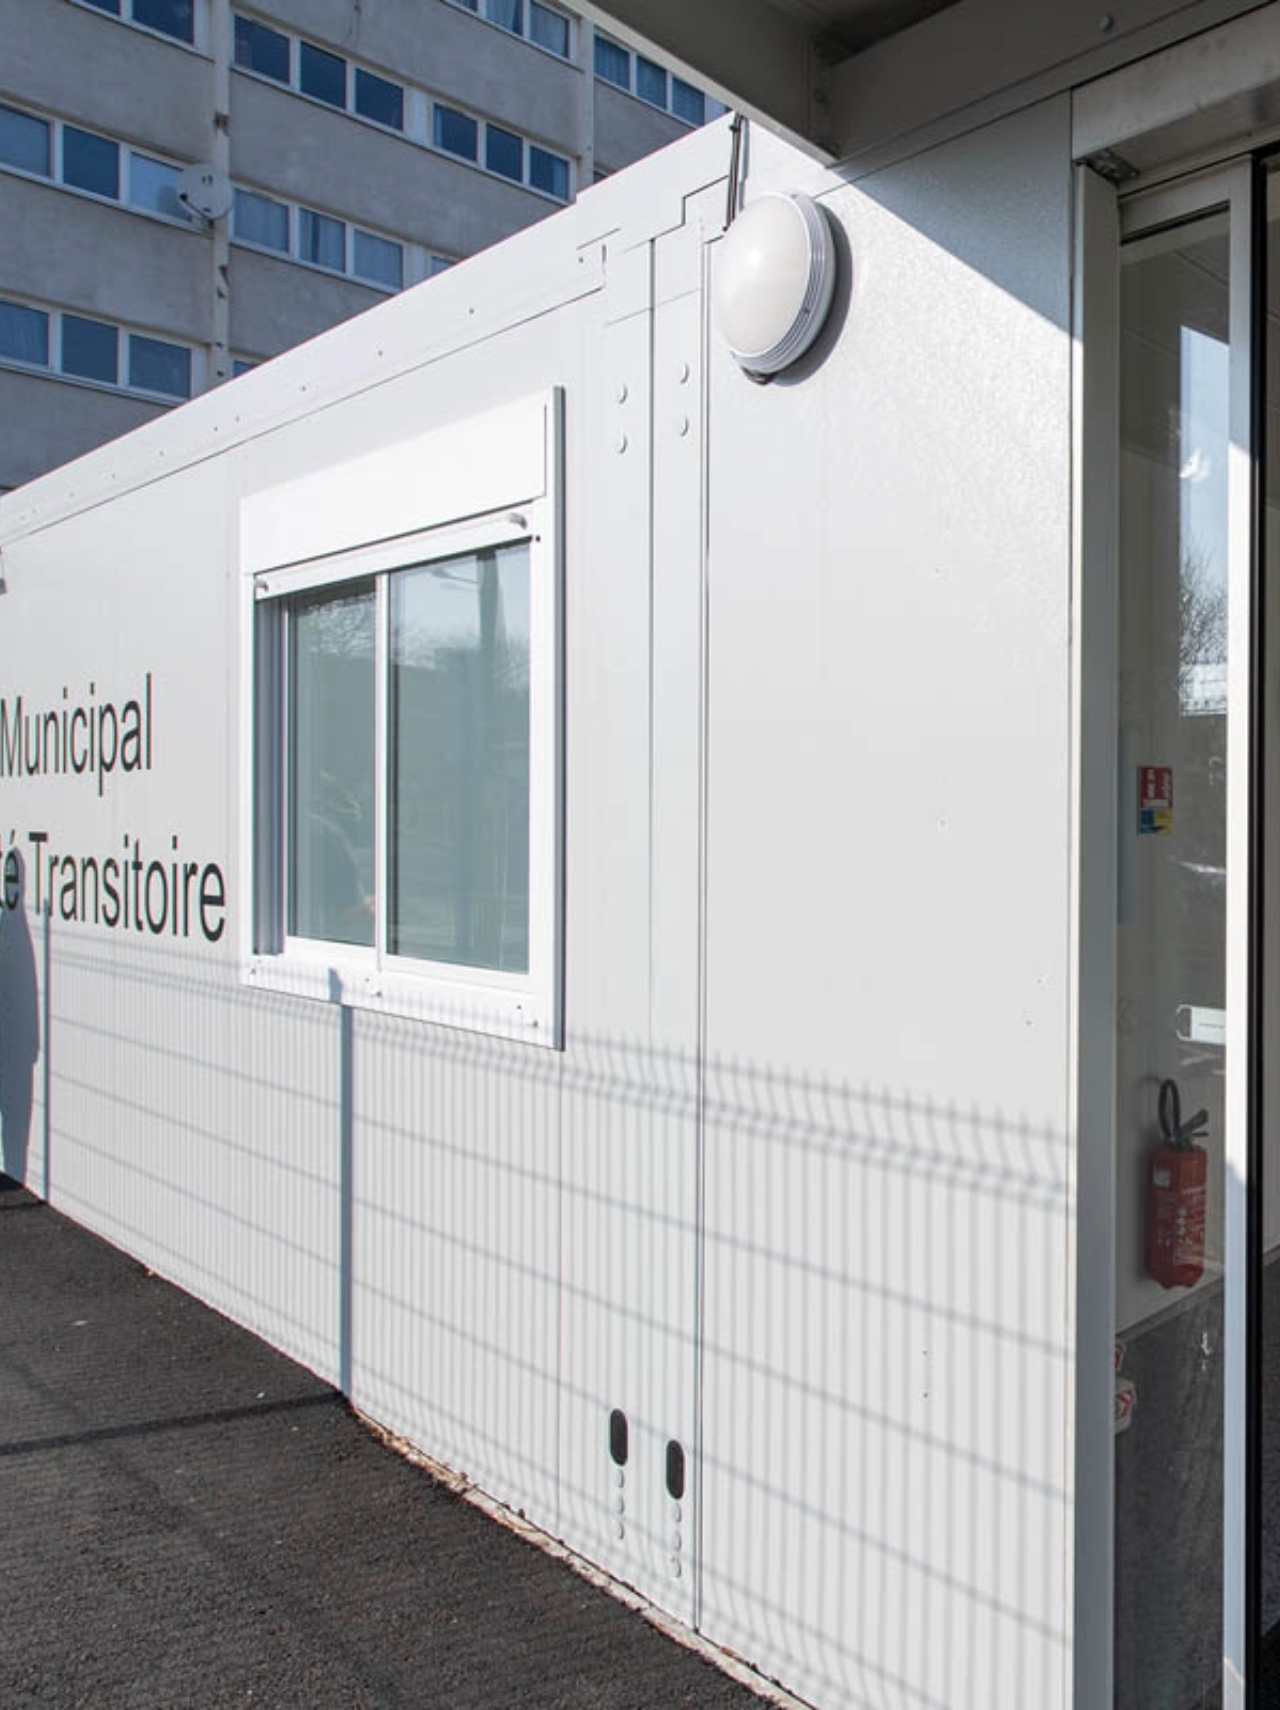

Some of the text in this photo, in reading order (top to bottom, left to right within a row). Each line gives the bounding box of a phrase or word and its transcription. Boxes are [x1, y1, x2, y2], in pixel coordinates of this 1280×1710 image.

[0, 671, 152, 797] Municipal
[0, 828, 226, 942] é Transitoire
